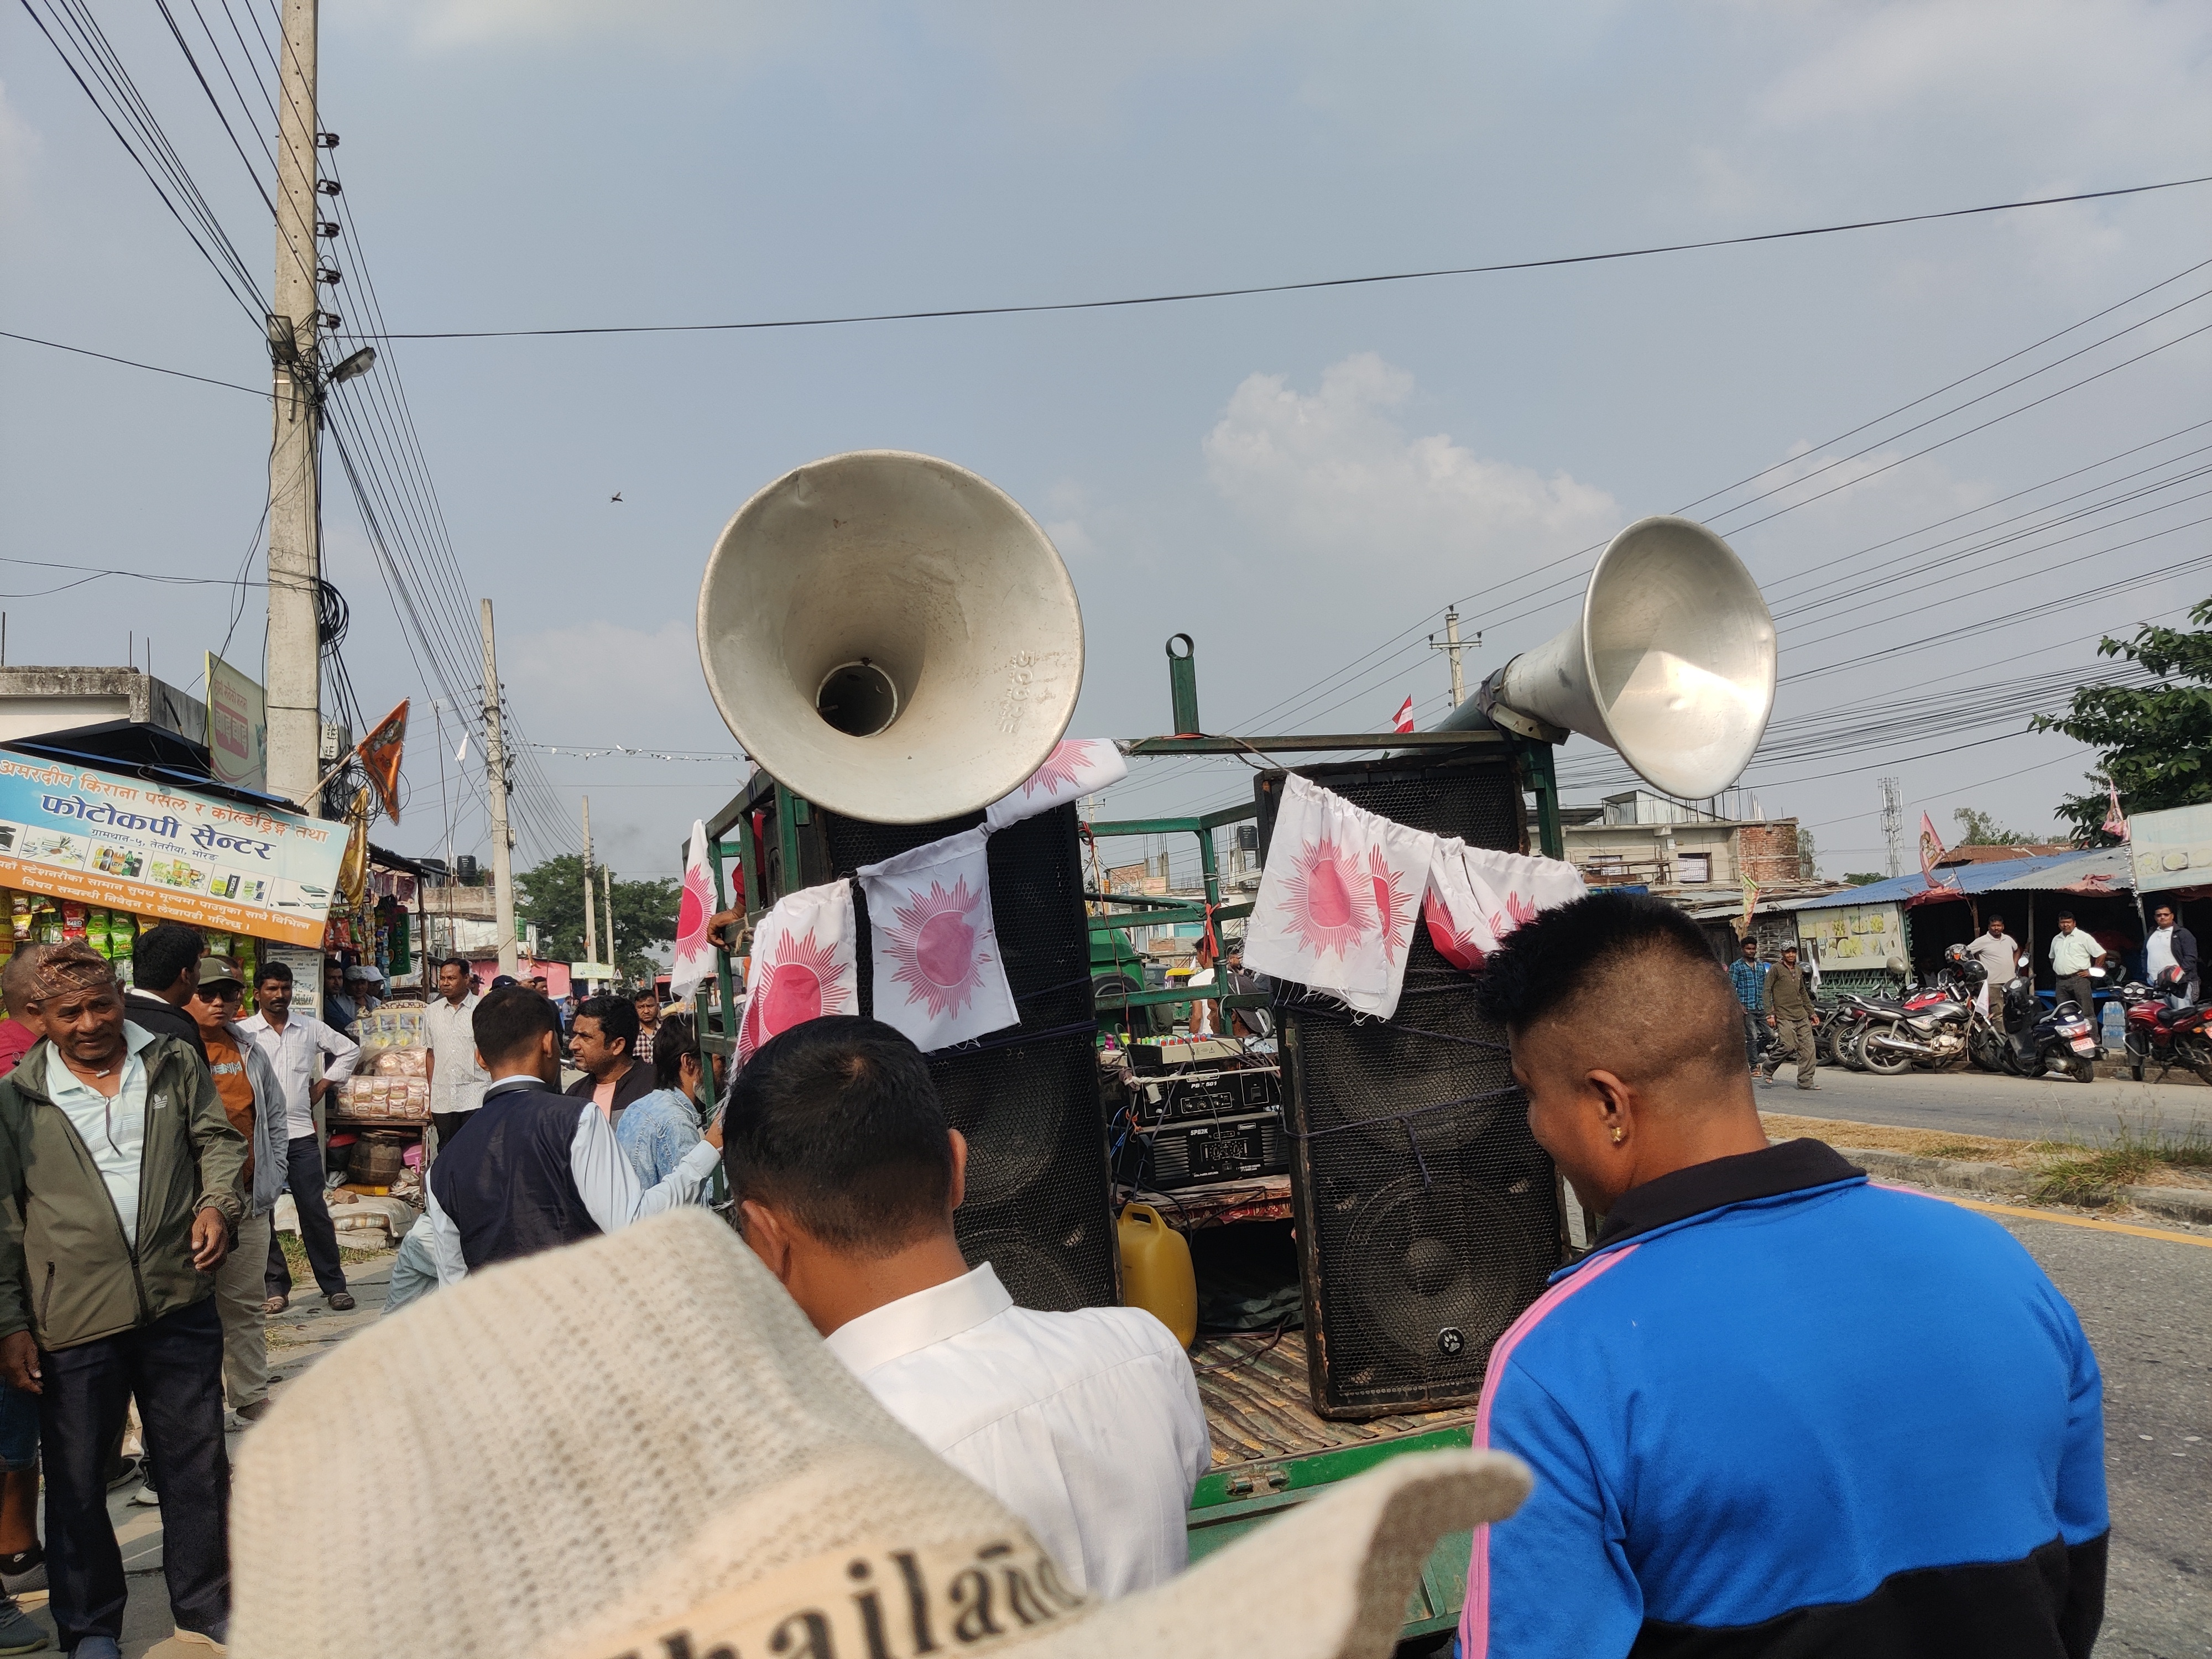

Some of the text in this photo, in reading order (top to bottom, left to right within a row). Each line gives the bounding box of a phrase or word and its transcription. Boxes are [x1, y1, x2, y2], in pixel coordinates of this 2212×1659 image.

[0, 760, 75, 787] अमरदीप
[80, 773, 140, 800] किराना
[145, 791, 189, 811] पसल
[195, 802, 206, 816] र
[295, 825, 330, 843] तथा
[42, 795, 276, 860] फोटोकपी सेन्टर
[22, 877, 54, 890] विषय
[57, 885, 101, 900] सम्बन्धी
[104, 892, 143, 908] निवेदन
[22, 865, 84, 883] स्टेशनरीका
[87, 878, 124, 891] सामान
[127, 885, 155, 898] सुपथ
[159, 892, 196, 906] मूल्यमा
[272, 914, 311, 930] विभिन्न
